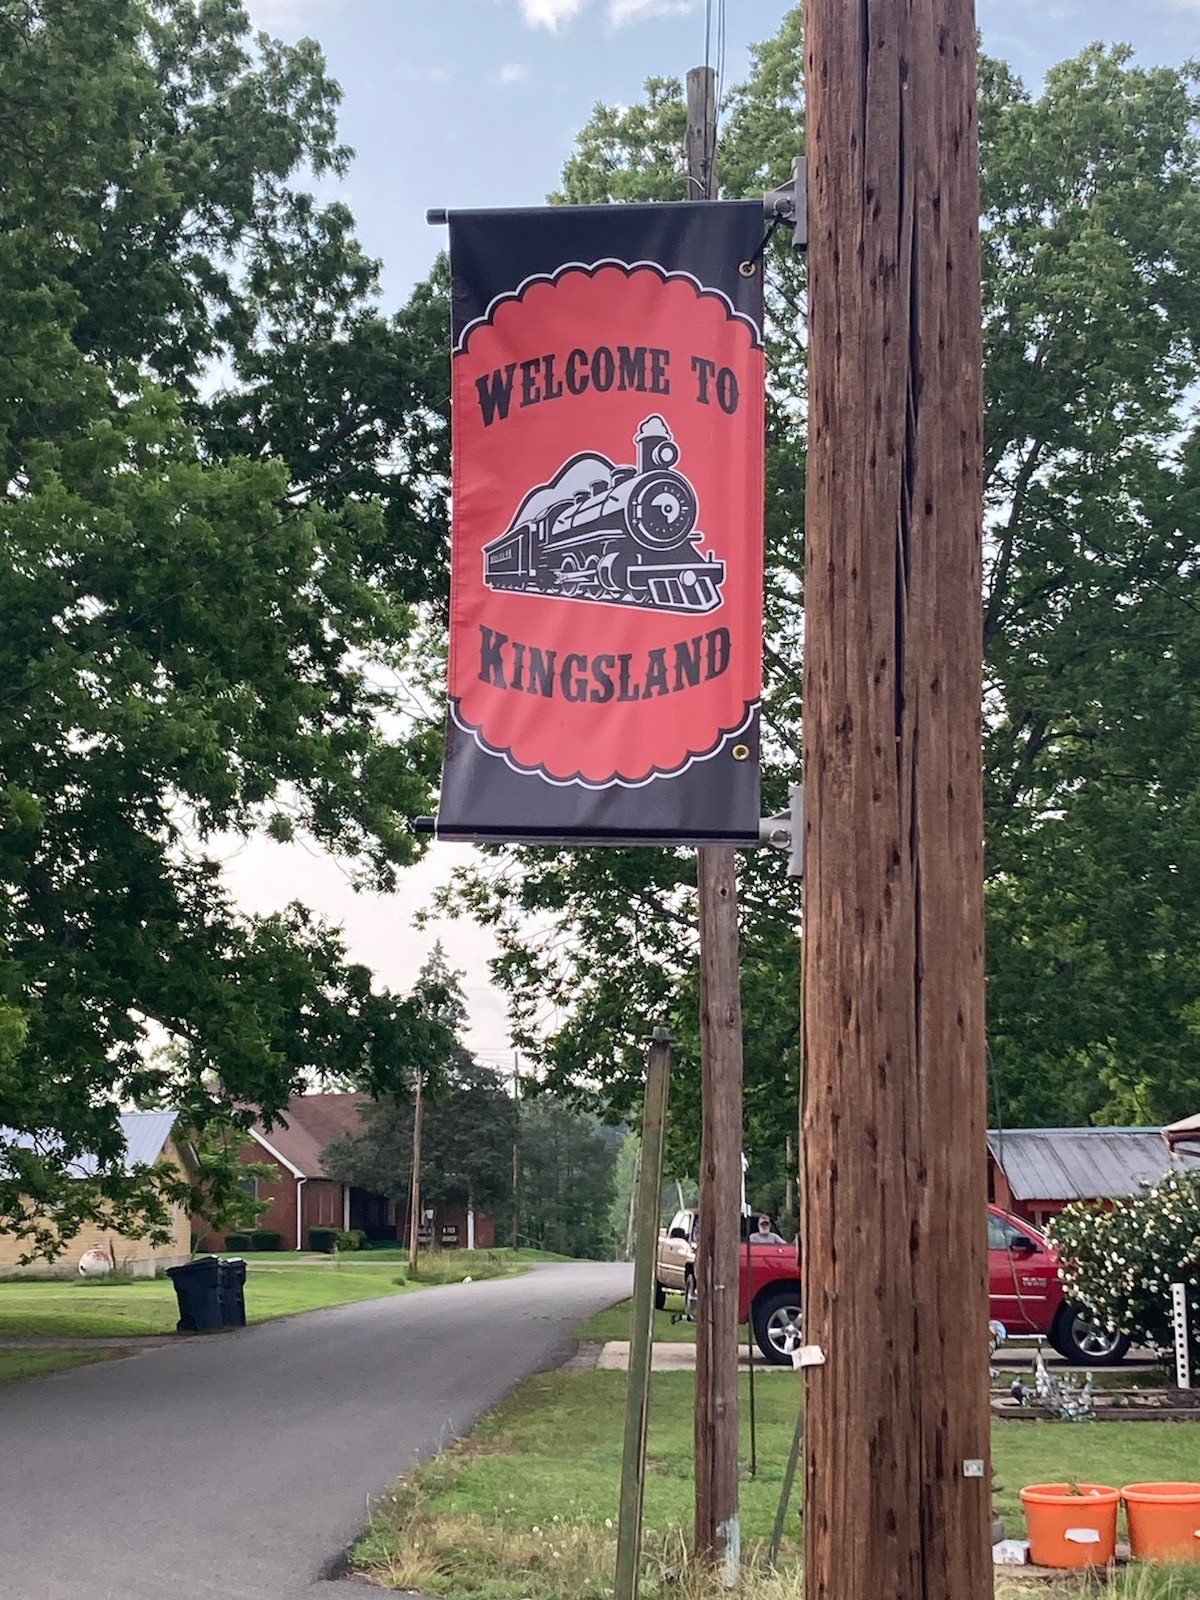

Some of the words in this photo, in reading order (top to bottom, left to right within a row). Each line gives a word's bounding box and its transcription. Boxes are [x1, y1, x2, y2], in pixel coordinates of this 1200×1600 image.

[475, 346, 670, 427] WELCOME
[691, 356, 739, 415] TO
[479, 625, 732, 703] KINGSLAND
